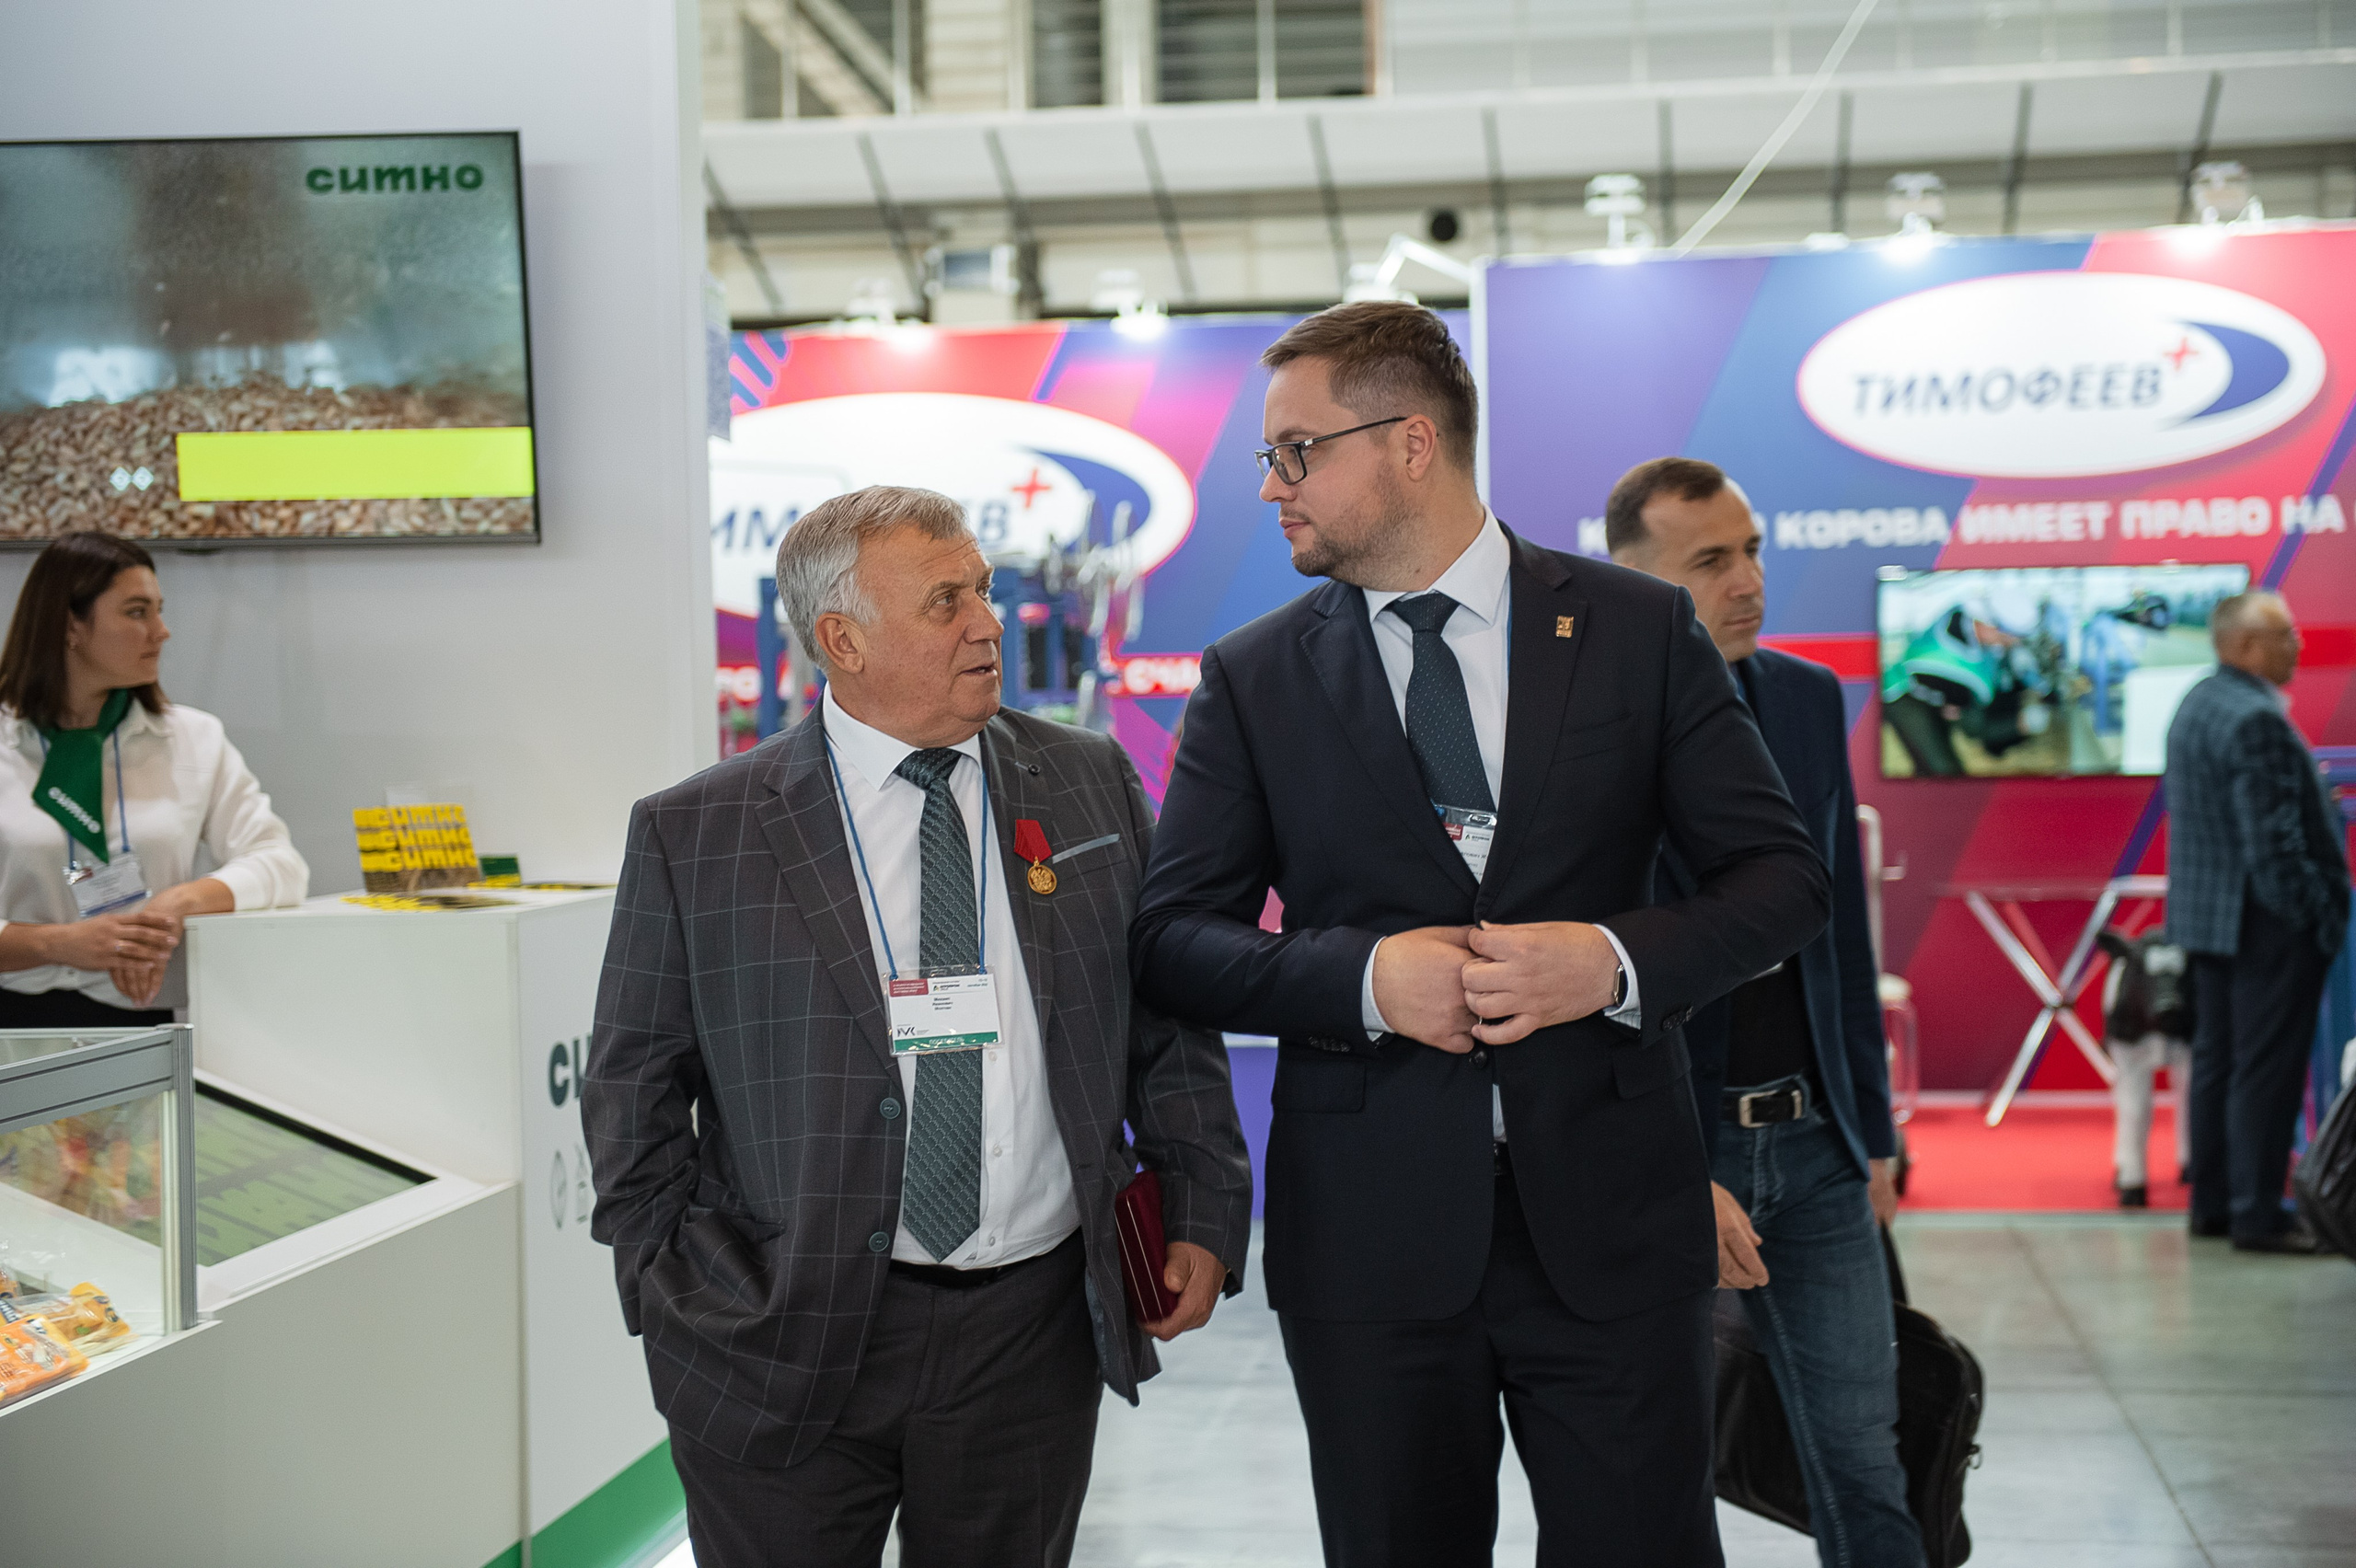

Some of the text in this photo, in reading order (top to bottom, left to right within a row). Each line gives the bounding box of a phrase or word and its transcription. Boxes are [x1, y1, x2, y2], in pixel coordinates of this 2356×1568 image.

[1852, 364, 2164, 418] ТИМОФЕЕВ
[1775, 505, 1949, 549] КОРОВА
[1958, 501, 2112, 545] ИМЕЕТ
[2119, 496, 2272, 539] ПРАВО
[2281, 493, 2347, 535] НА
